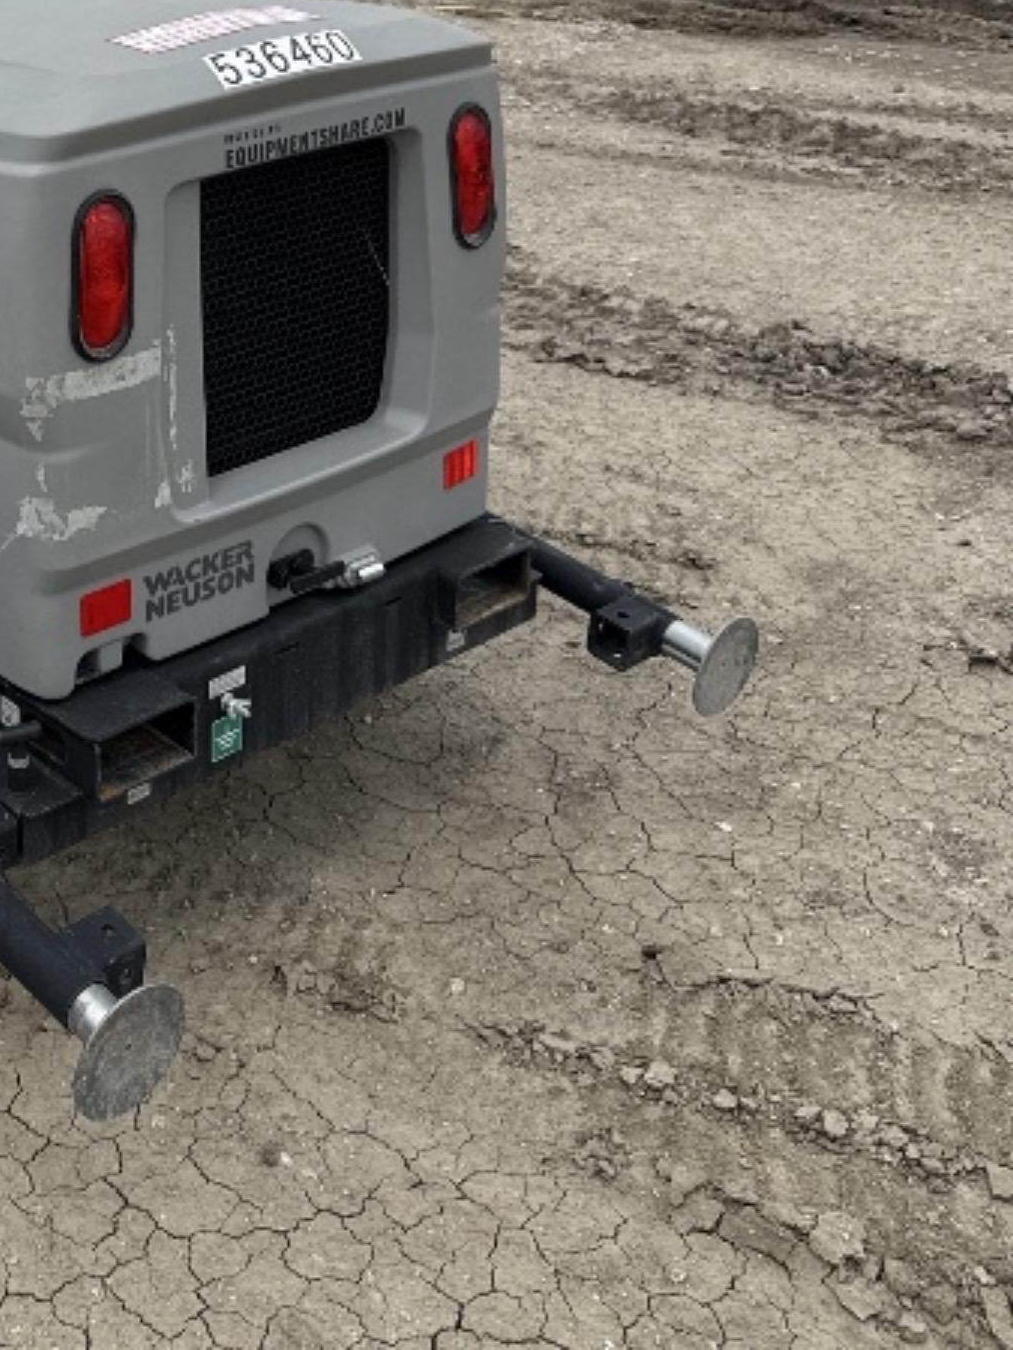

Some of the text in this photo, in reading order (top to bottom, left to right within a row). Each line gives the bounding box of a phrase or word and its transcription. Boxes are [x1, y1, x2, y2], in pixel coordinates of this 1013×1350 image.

[208, 30, 356, 86] 536460
[225, 107, 407, 170] EQUIPMENTSHARE.COM
[144, 540, 254, 596] WACKER
[146, 561, 254, 623] NEUSON
